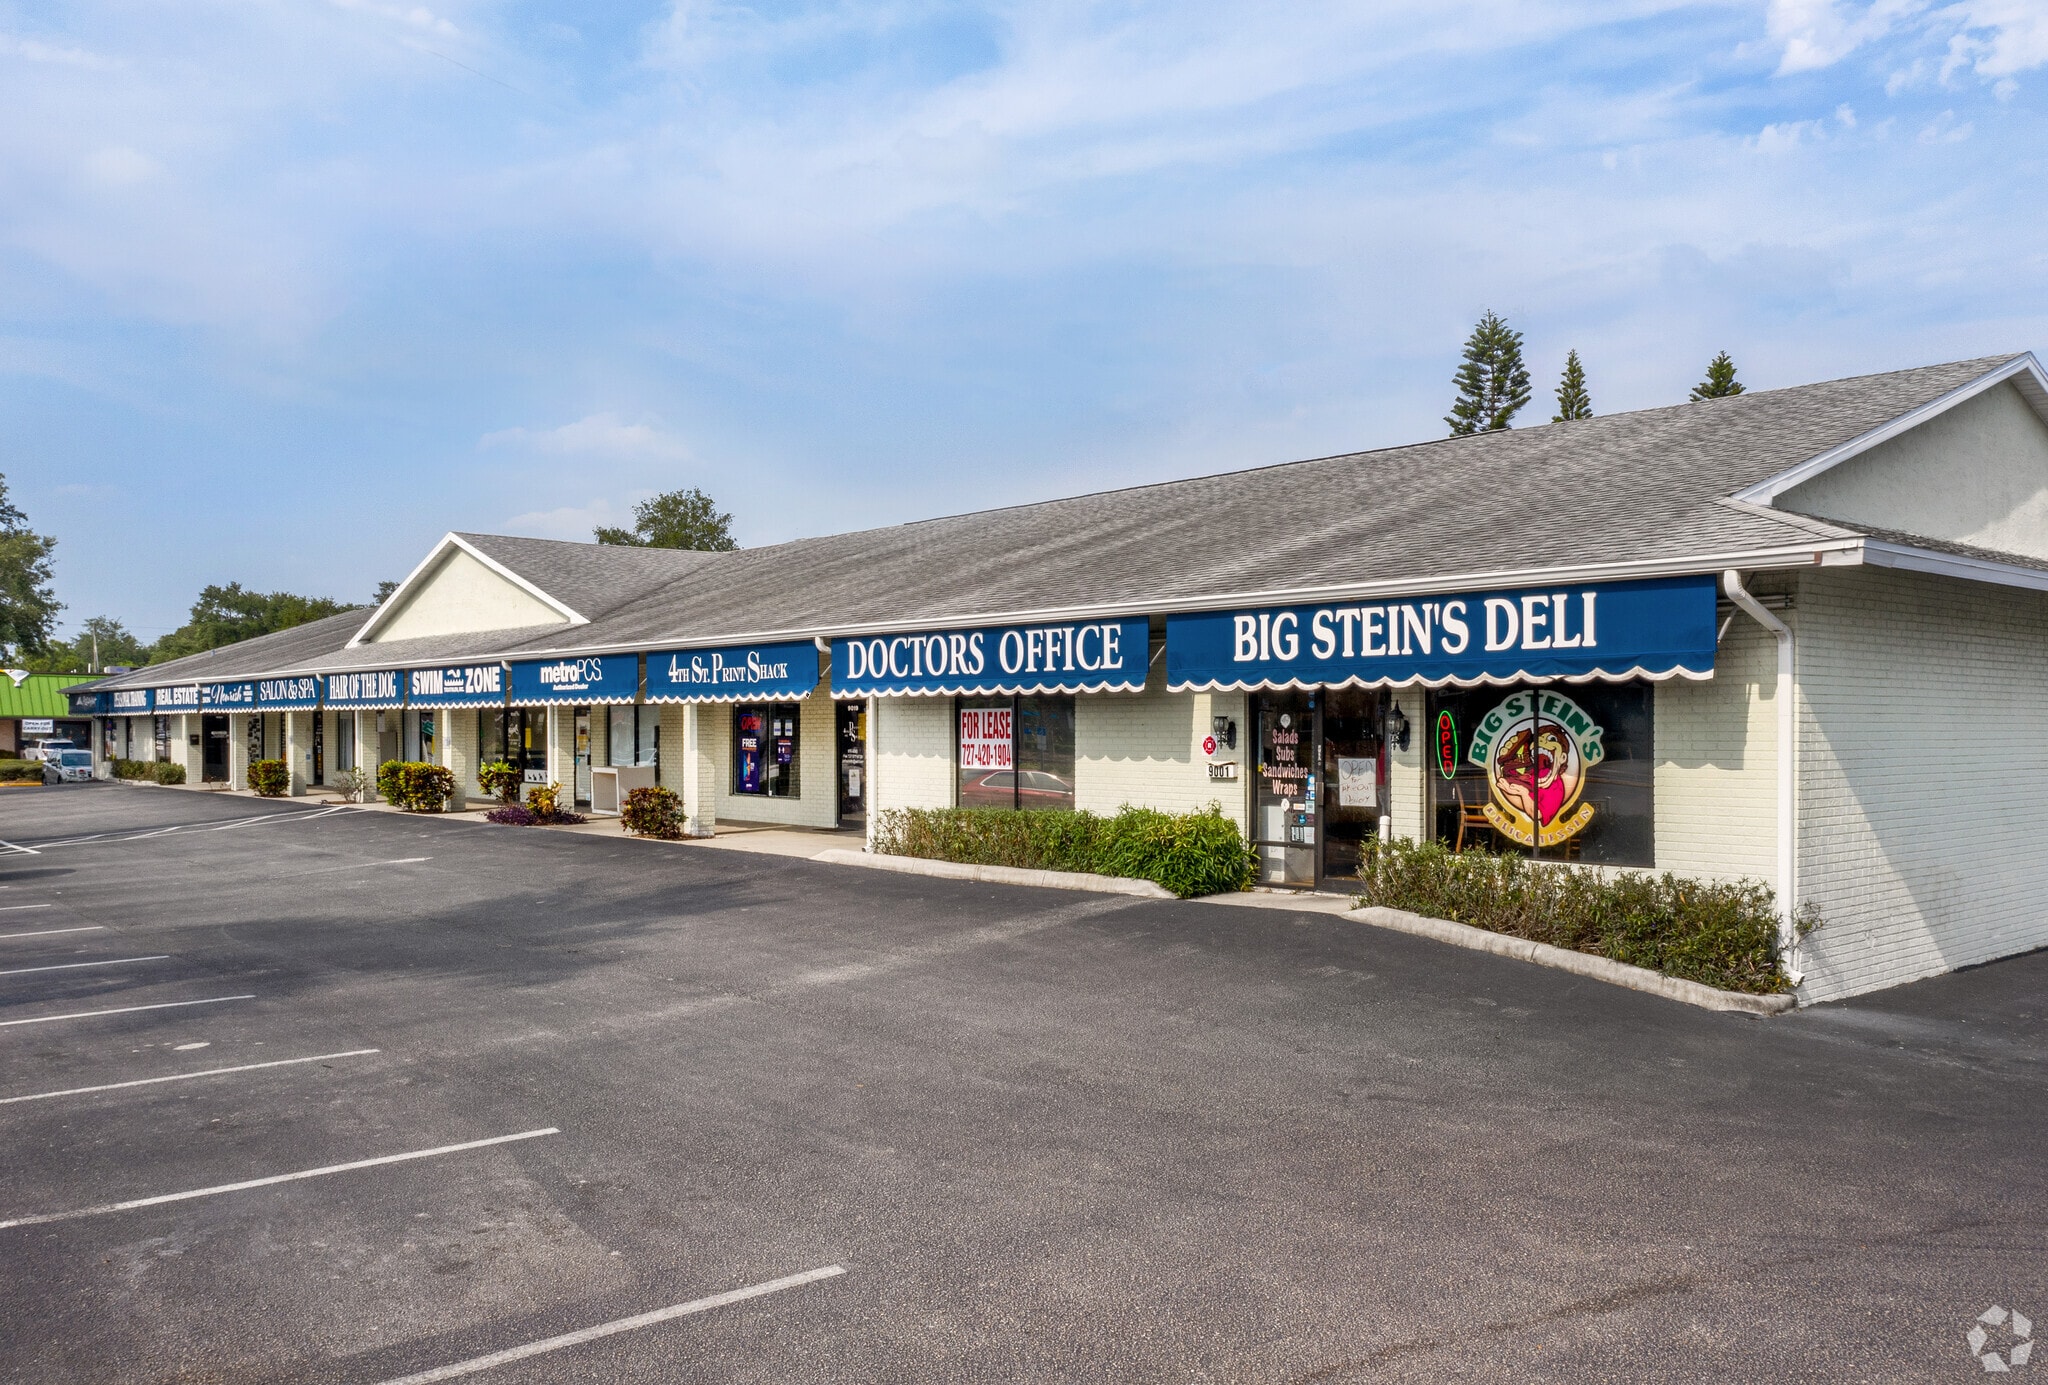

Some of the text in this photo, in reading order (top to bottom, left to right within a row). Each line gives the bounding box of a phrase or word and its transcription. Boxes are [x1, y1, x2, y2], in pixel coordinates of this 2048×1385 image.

[1233, 591, 1598, 662] BIG STEIN'S DELI
[847, 624, 1123, 679] DOCTORS OFFICE
[540, 657, 602, 683] metroPCS
[747, 651, 789, 683] SHACK
[260, 678, 316, 701] SALON & SPA
[329, 671, 397, 700] HAIR OF THE DOG
[412, 666, 501, 696] SWIM ZONE
[156, 688, 173, 705] REAL
[173, 687, 199, 705] ESTATE
[961, 711, 1011, 740] FOR LEASE
[1272, 728, 1299, 745] Salads
[1471, 693, 1602, 764] BIG STEIN'S
[741, 738, 758, 748] FREE
[961, 744, 1012, 766] 727-420-1904
[1276, 745, 1295, 761] Subs
[1440, 716, 1453, 773] OPEN
[1208, 765, 1230, 778] 9001
[1262, 762, 1309, 779] Sandwiches
[1272, 779, 1298, 798] Wraps
